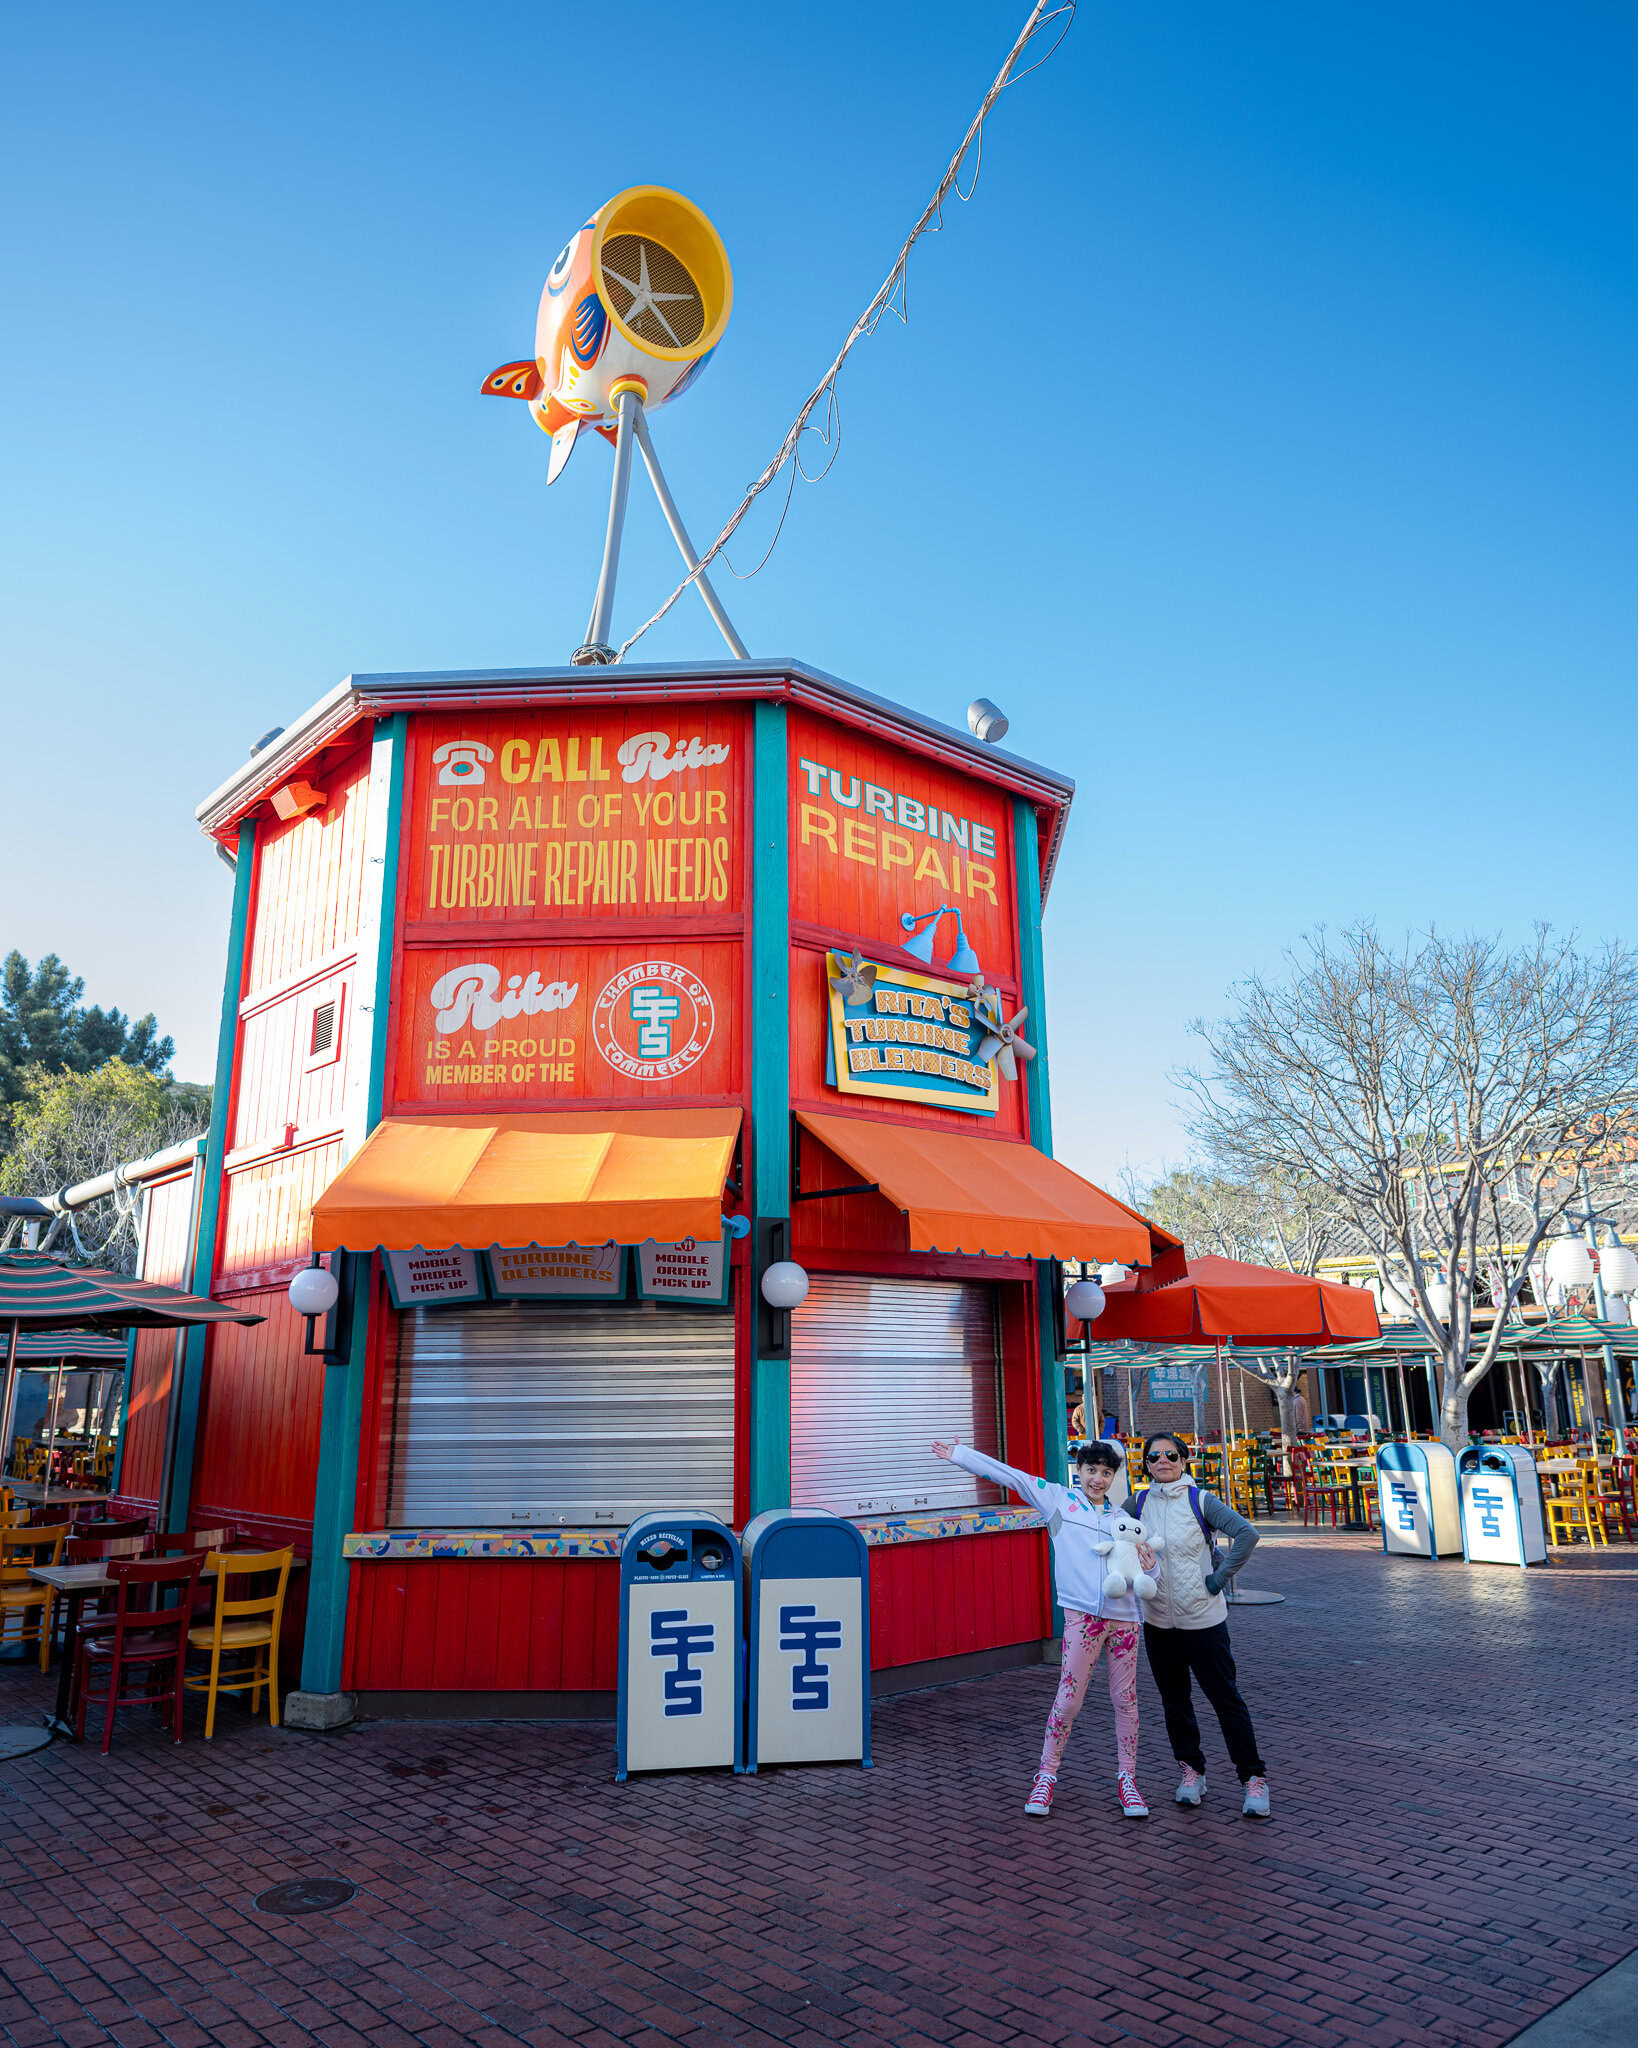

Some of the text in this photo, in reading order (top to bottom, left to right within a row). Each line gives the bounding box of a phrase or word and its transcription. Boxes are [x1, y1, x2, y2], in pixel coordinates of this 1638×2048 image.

[500, 731, 730, 784] CALL Rita
[430, 791, 728, 832] FOR ALL OF YOUR
[800, 757, 996, 859] TURBINE
[800, 802, 998, 906] REPAIR
[429, 836, 729, 909] TURBINE REPAIR NEEDS
[430, 963, 579, 1035] Rita
[599, 964, 709, 1009] CHAMBER OF
[875, 989, 971, 1028] RITA'S
[427, 1038, 576, 1060] IS A PROUD
[845, 1018, 971, 1055] TURBINE
[425, 1062, 575, 1085] MEMBER OF THE
[604, 1040, 703, 1077] COMMERCE
[849, 1047, 993, 1090] BLENDERS
[408, 1257, 462, 1270] MOBILE
[497, 1252, 595, 1267] TURBINE
[501, 1266, 613, 1282] BLENDERS
[655, 1254, 710, 1265] MOBILE
[656, 1266, 708, 1277] ORDER
[410, 1280, 468, 1293] PICK UP
[412, 1269, 462, 1281] ORDER
[652, 1277, 712, 1289] PICK UP
[640, 1532, 685, 1547] MIXED RECYCLING
